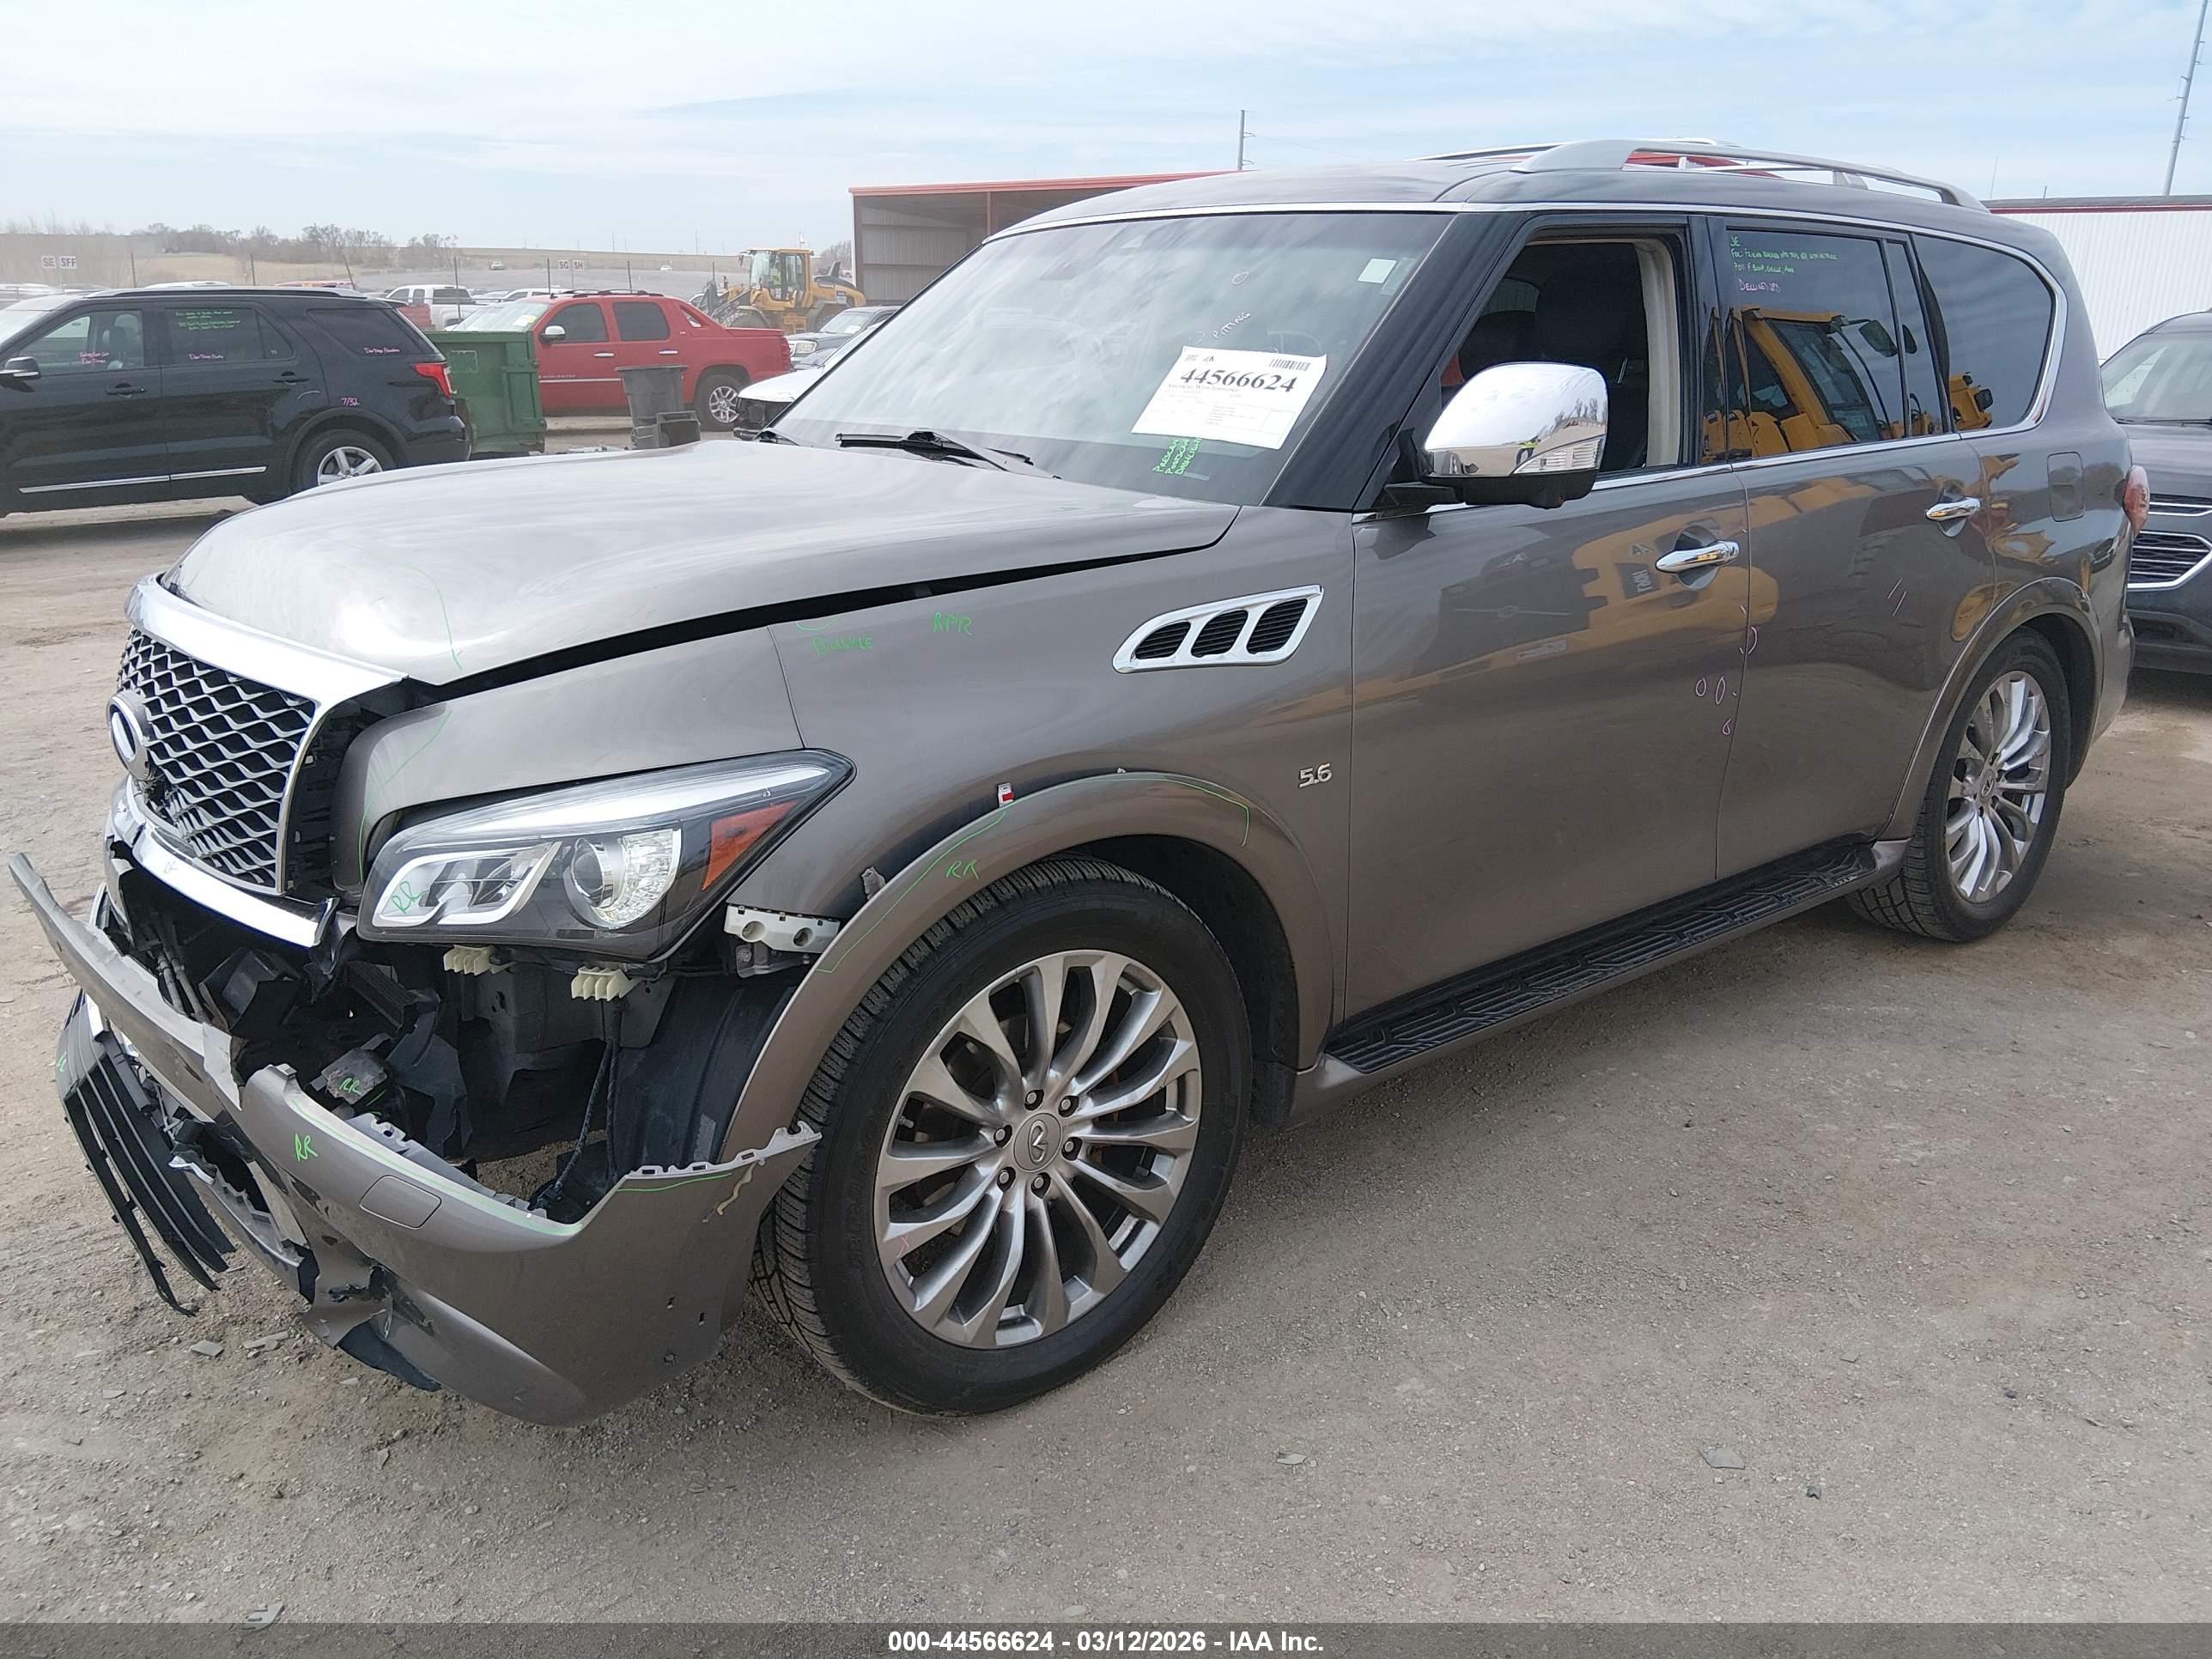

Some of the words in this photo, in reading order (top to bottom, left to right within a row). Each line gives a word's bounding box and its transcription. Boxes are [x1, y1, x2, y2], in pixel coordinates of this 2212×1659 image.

[574, 261, 584, 270] SH
[1180, 368, 1298, 392] 44566624
[1298, 762, 1333, 788] 5.6
[338, 1077, 363, 1096] RR
[294, 1132, 319, 1162] RR
